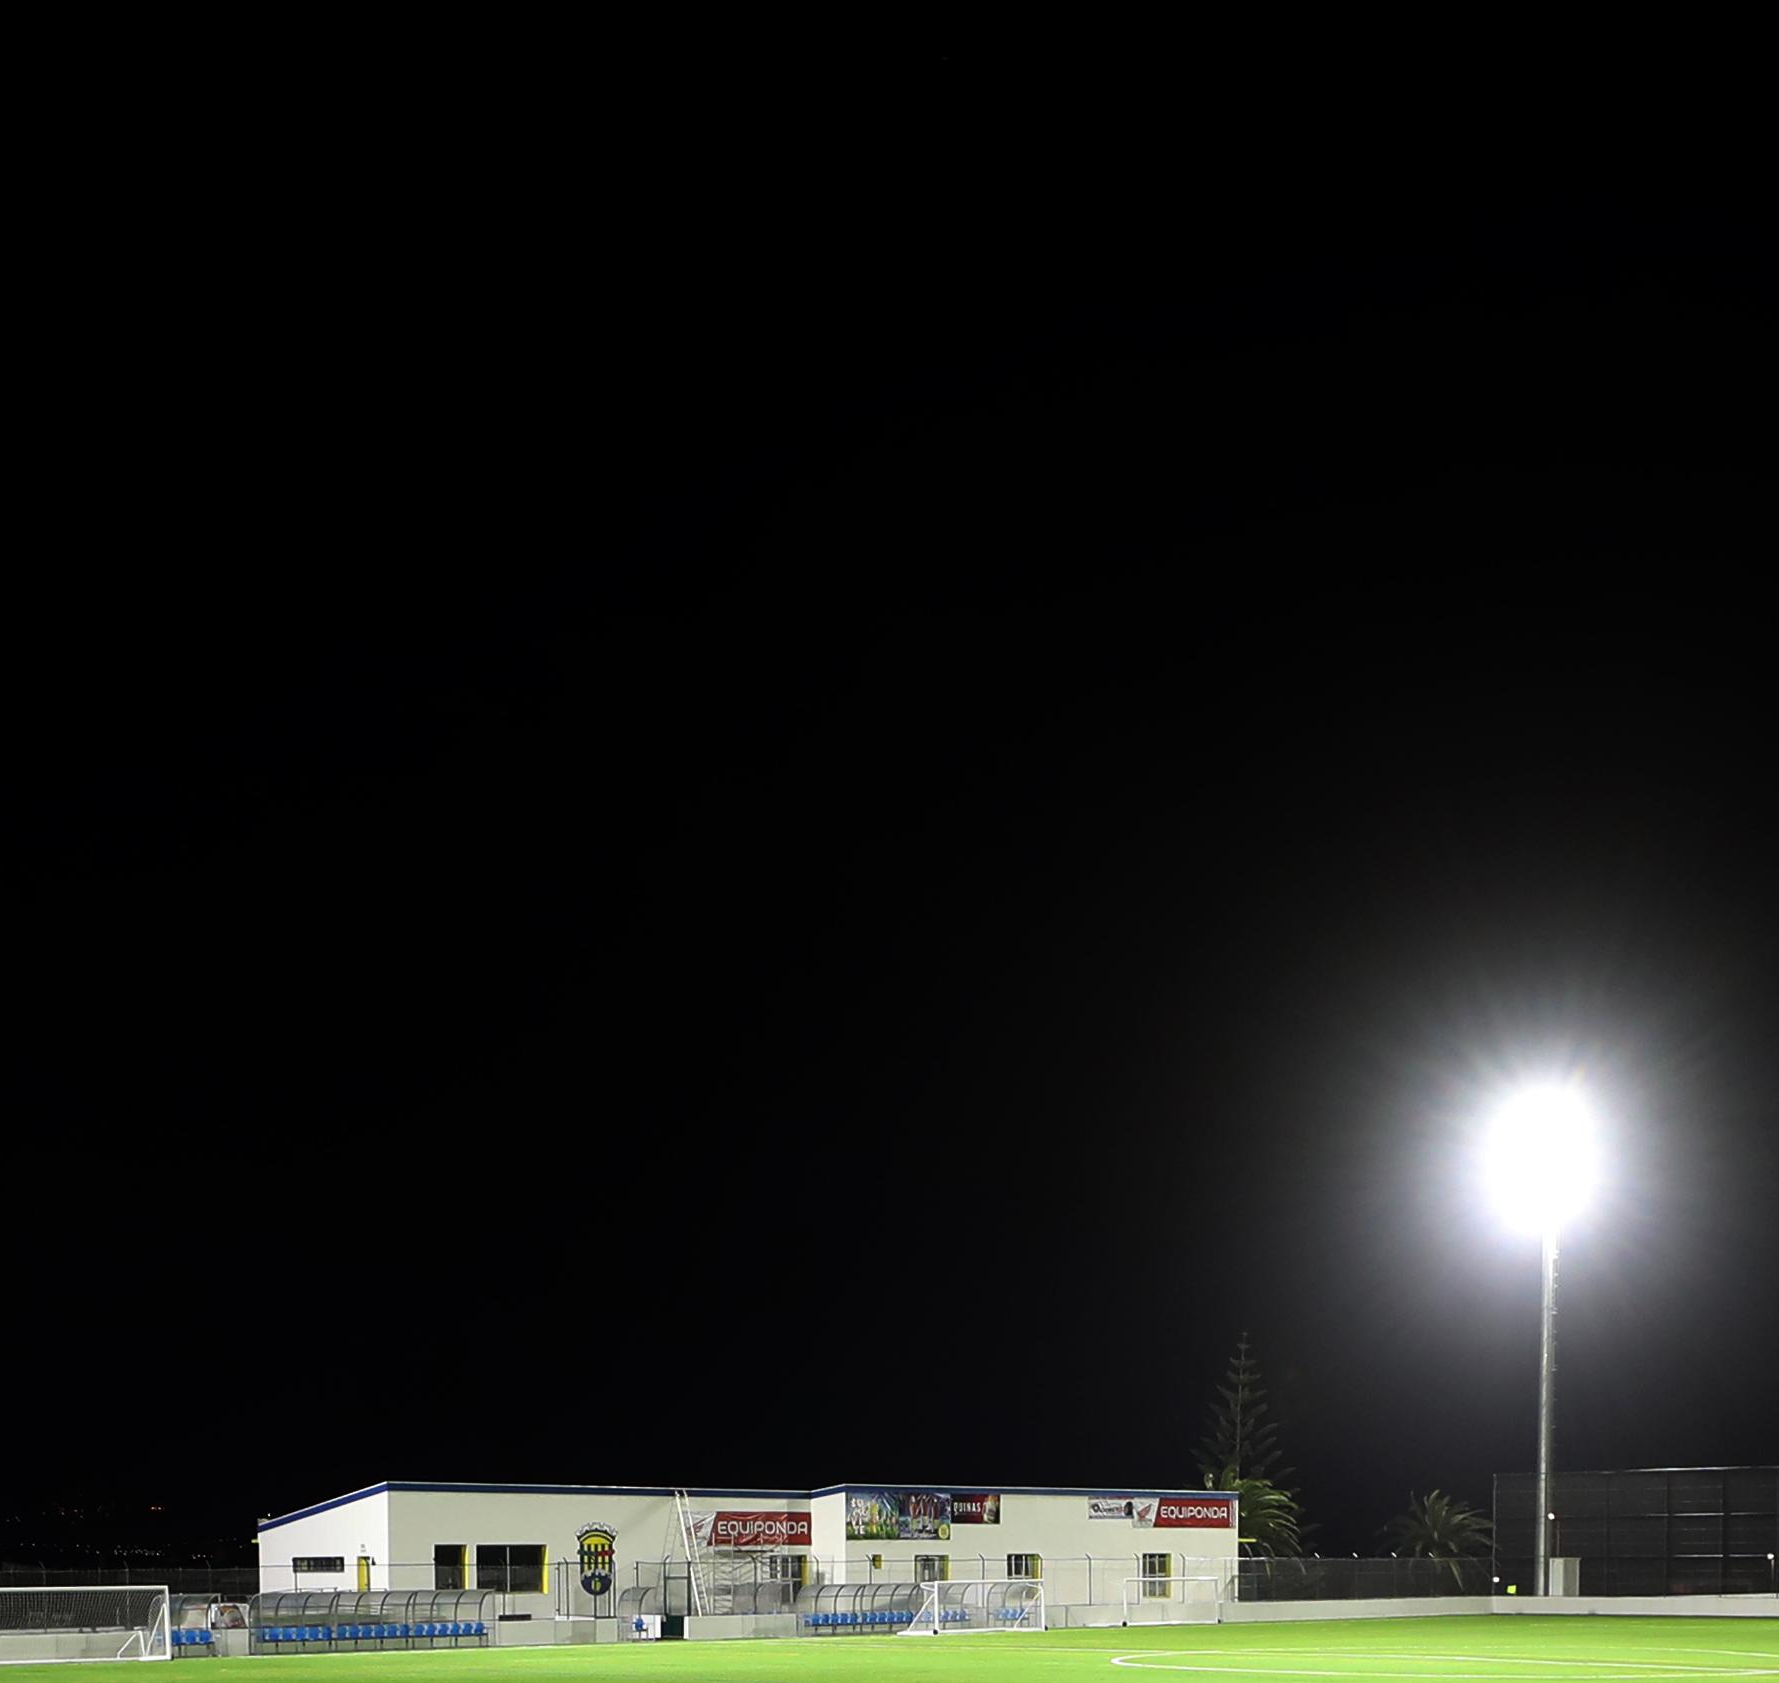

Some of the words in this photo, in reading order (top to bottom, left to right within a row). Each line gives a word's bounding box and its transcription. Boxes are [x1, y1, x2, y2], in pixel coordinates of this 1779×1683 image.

[953, 1502, 981, 1515] QUINAS
[1161, 1506, 1228, 1519] EQUIPONDA
[717, 1521, 808, 1536] EQUIPONDA
